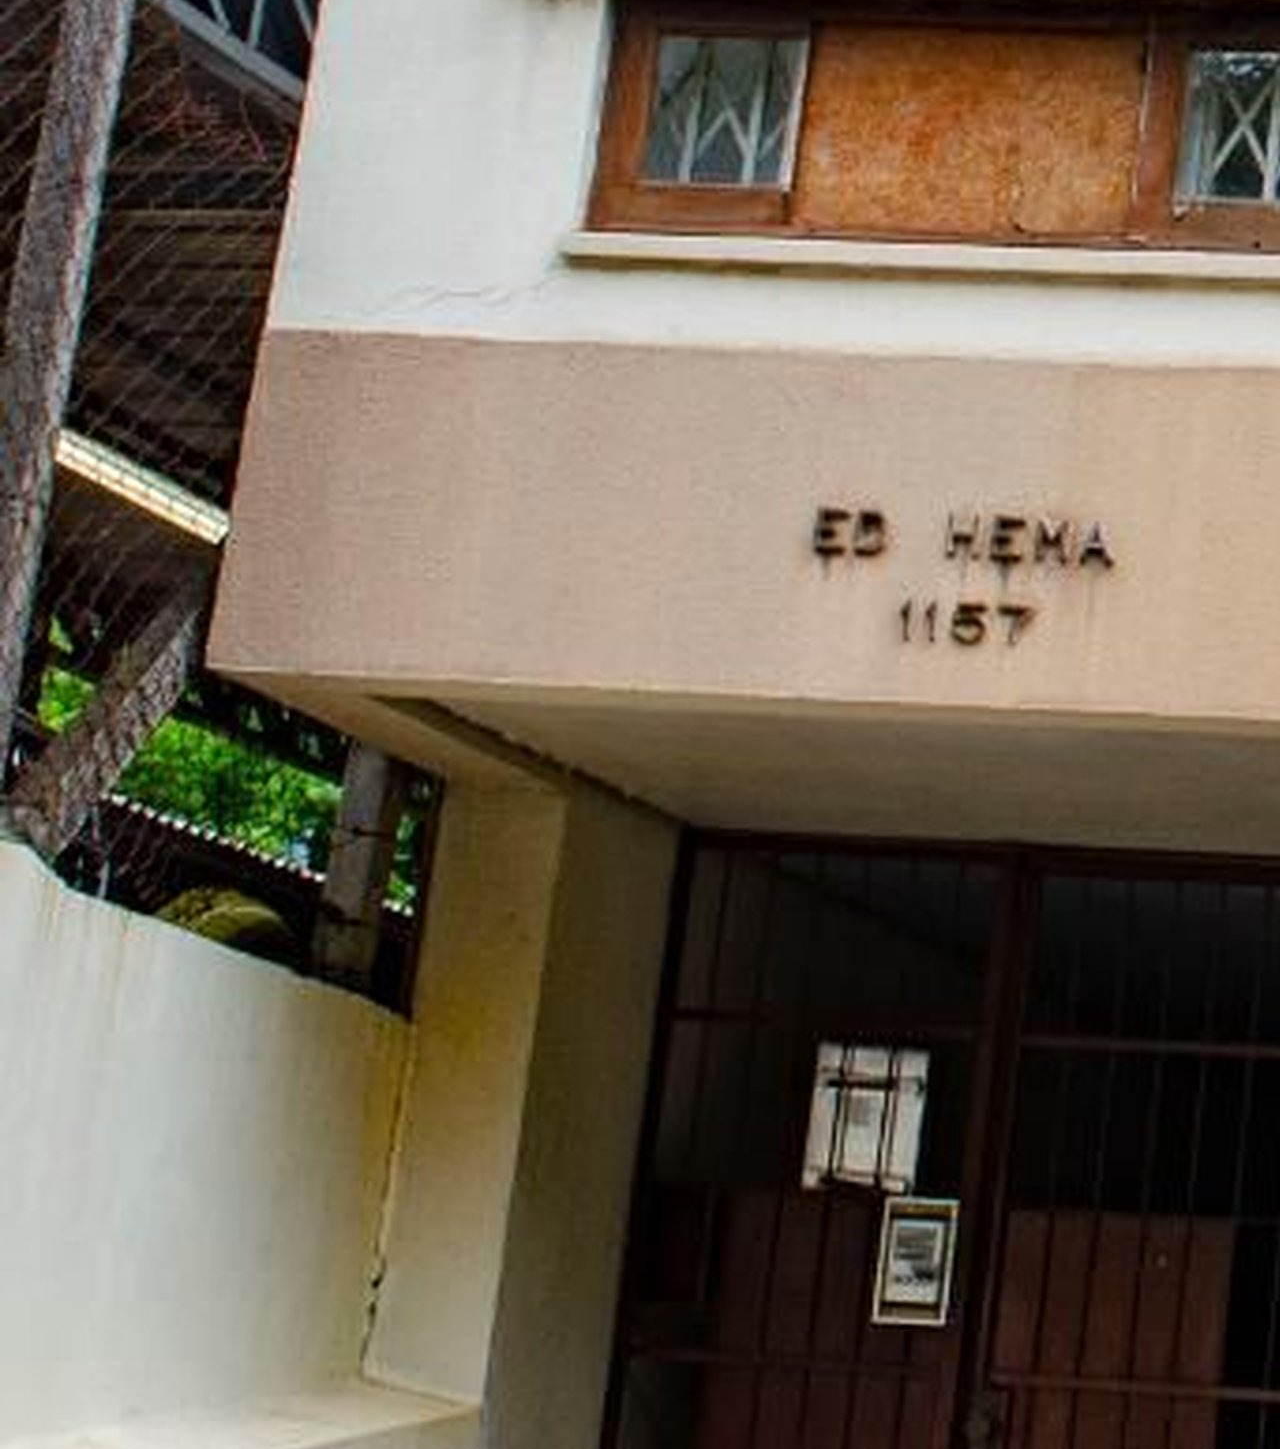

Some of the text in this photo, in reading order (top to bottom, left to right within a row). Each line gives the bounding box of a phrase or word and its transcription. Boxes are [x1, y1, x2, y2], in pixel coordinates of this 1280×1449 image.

[812, 508, 1115, 570] ED HEMA
[900, 600, 1036, 646] 1157
